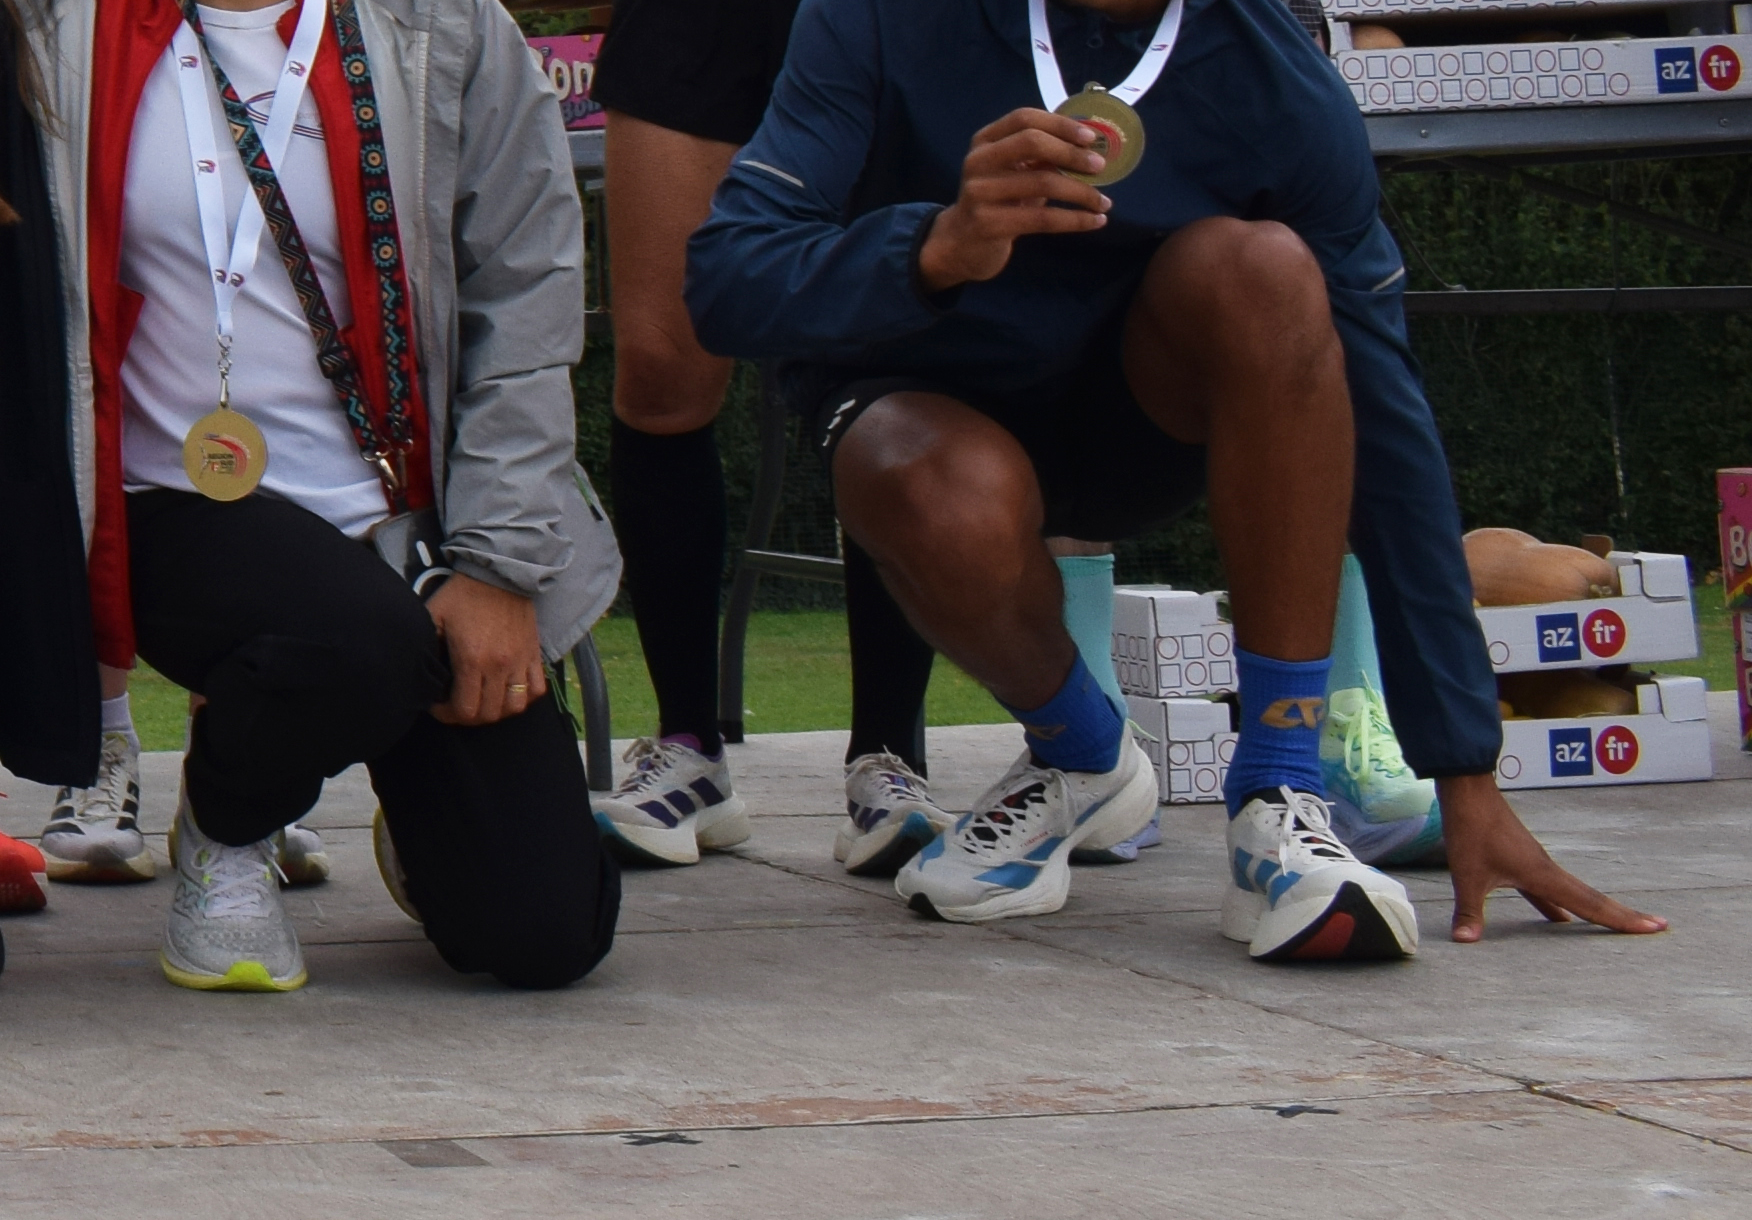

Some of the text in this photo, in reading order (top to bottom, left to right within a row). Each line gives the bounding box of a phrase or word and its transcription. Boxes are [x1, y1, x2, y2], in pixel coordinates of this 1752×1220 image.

[1660, 55, 1731, 80] az fr
[1543, 620, 1617, 648] az fr
[1555, 736, 1630, 763] az fr
